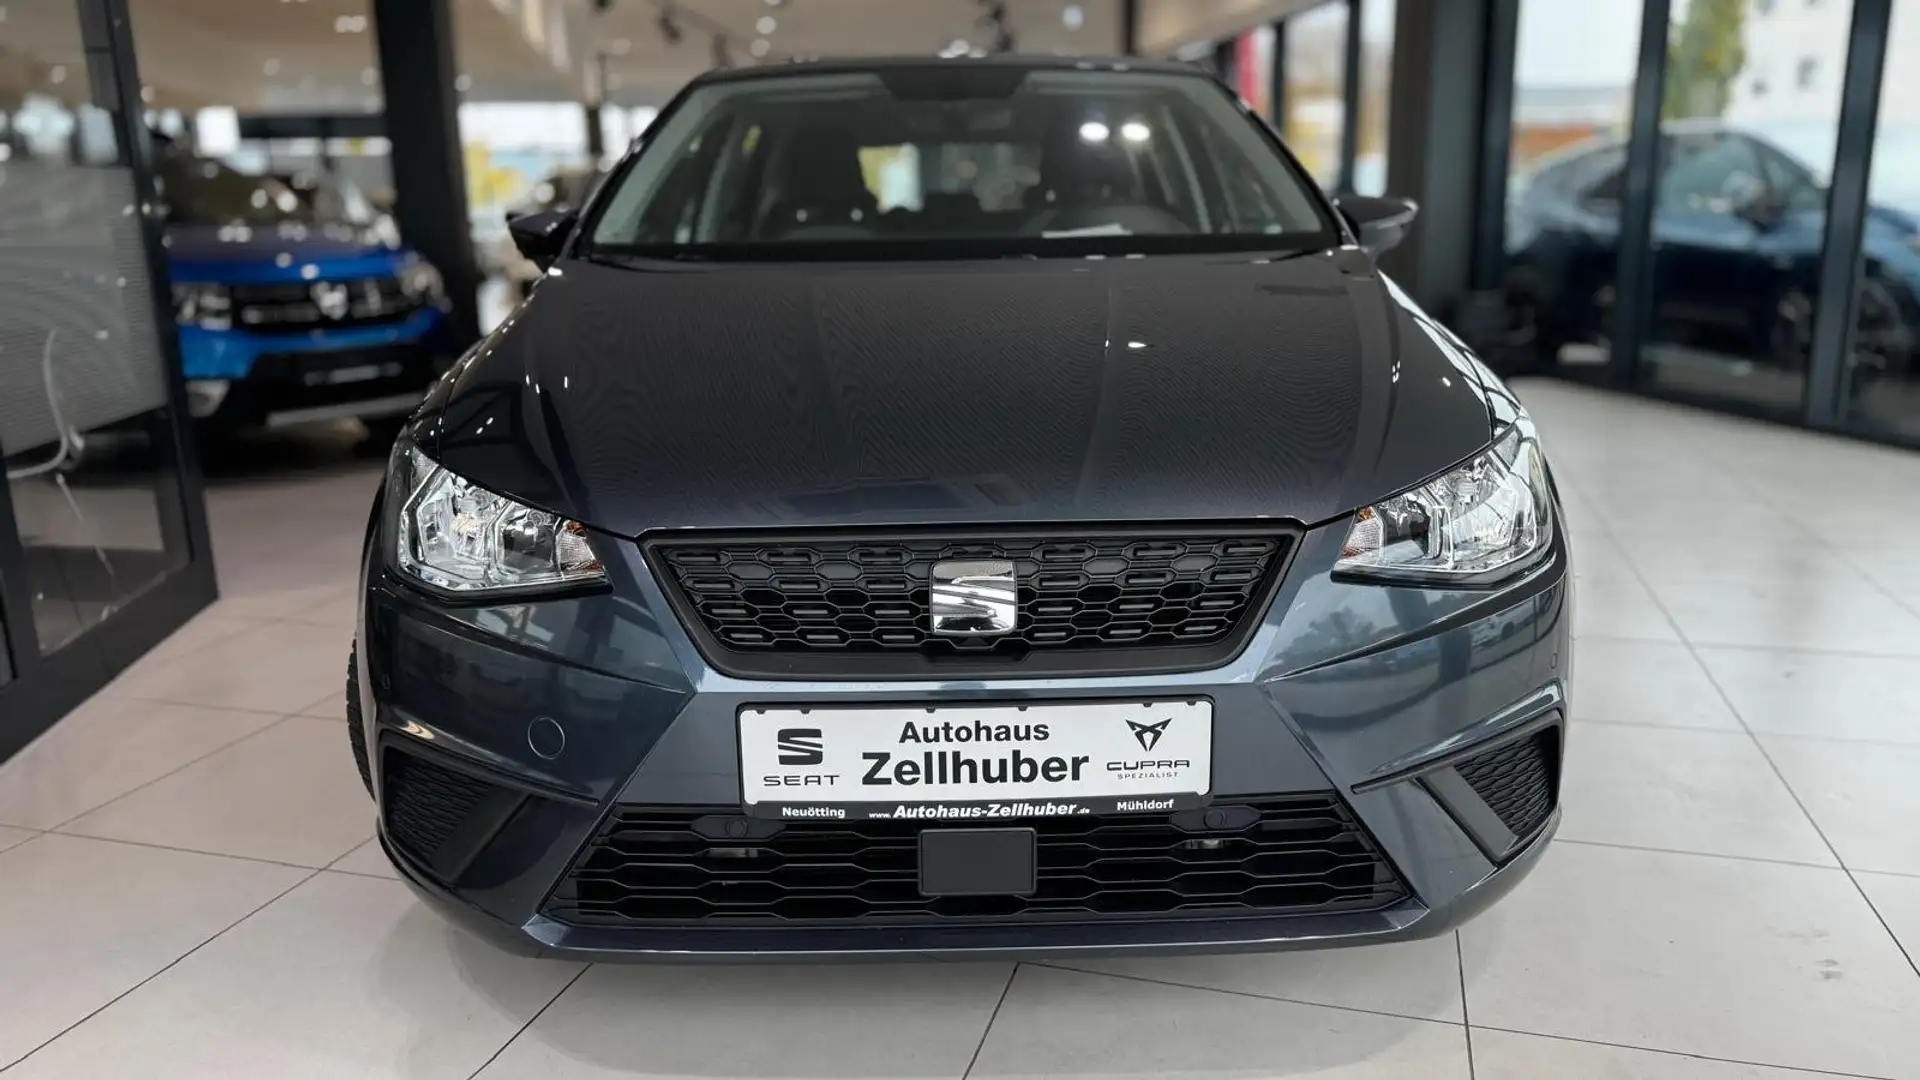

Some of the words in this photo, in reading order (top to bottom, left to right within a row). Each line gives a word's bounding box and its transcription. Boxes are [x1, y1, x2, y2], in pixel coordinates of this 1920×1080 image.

[899, 720, 1050, 744] Autohaus
[862, 751, 1090, 785] Zellhuber
[1106, 760, 1190, 771] CUPRA
[763, 775, 840, 786] SEAT
[1117, 771, 1179, 780] SPEZIALIST
[1116, 798, 1175, 811] Mühldorf
[782, 806, 846, 819] Neuötting
